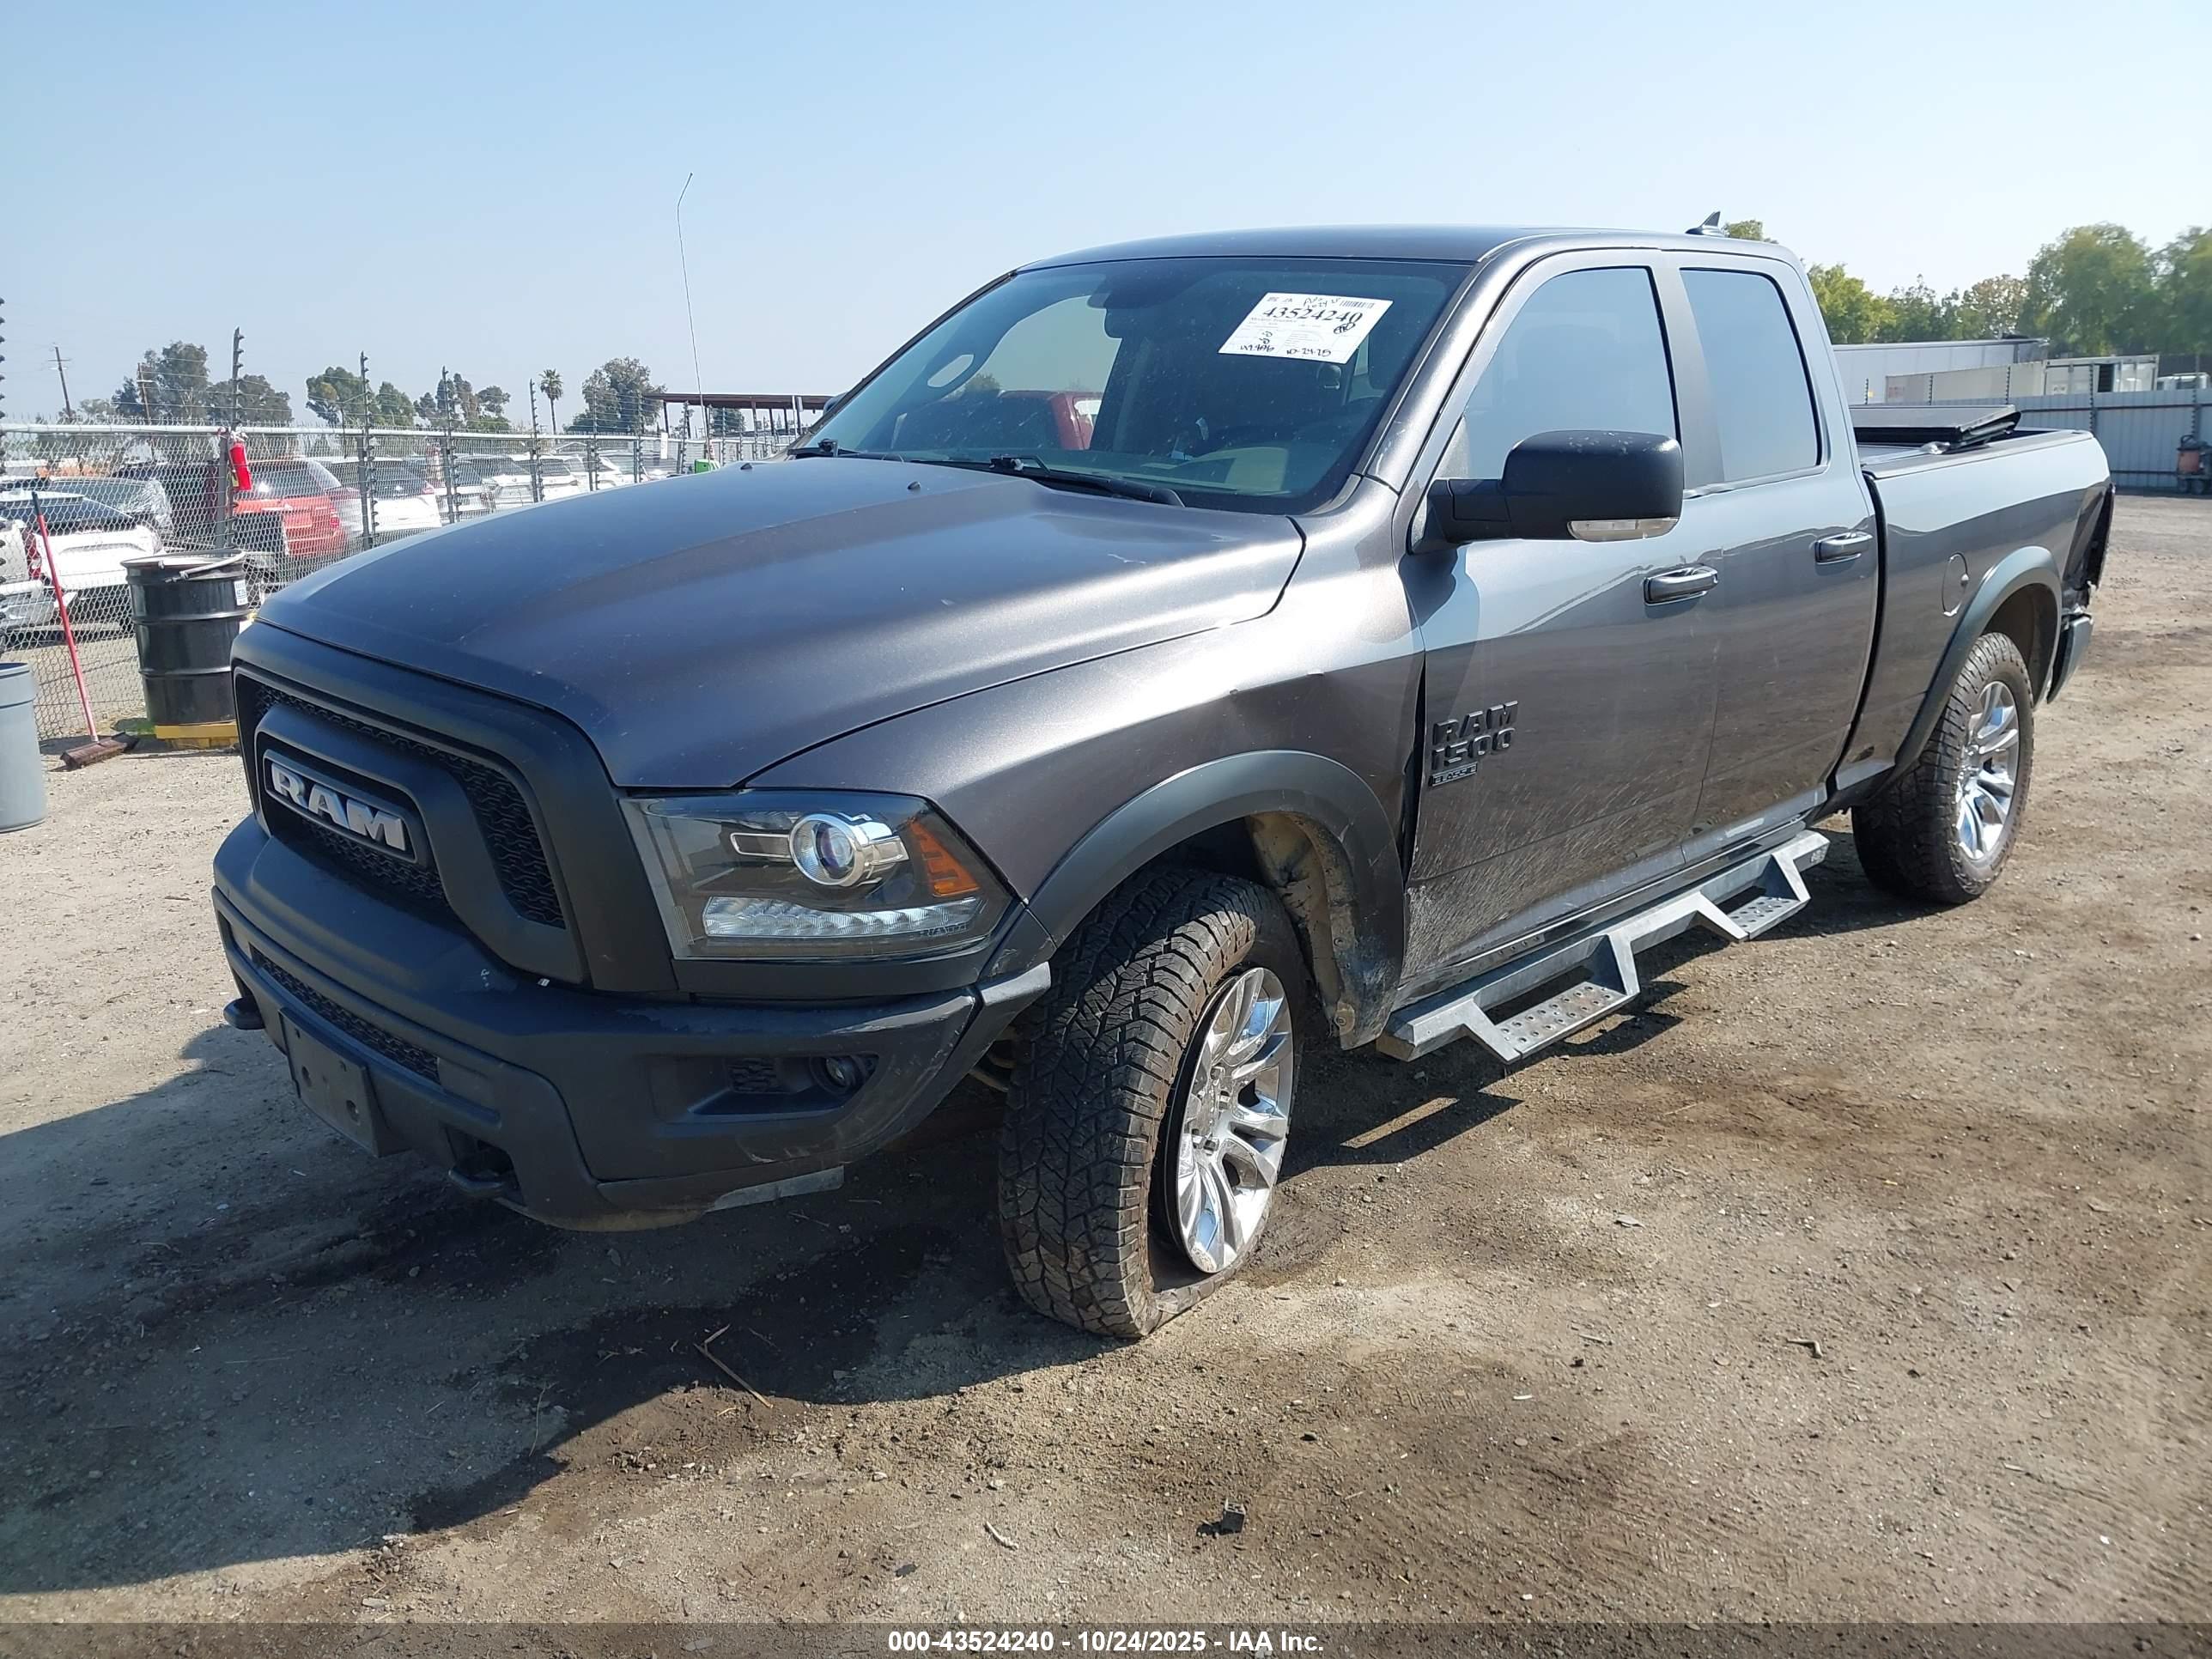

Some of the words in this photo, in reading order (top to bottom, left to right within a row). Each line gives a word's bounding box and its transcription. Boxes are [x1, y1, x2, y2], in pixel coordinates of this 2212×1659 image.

[1262, 306, 1364, 324] 43524240
[1432, 700, 1519, 746] RAM
[1431, 727, 1516, 770] 1500
[270, 762, 406, 852] RAM
